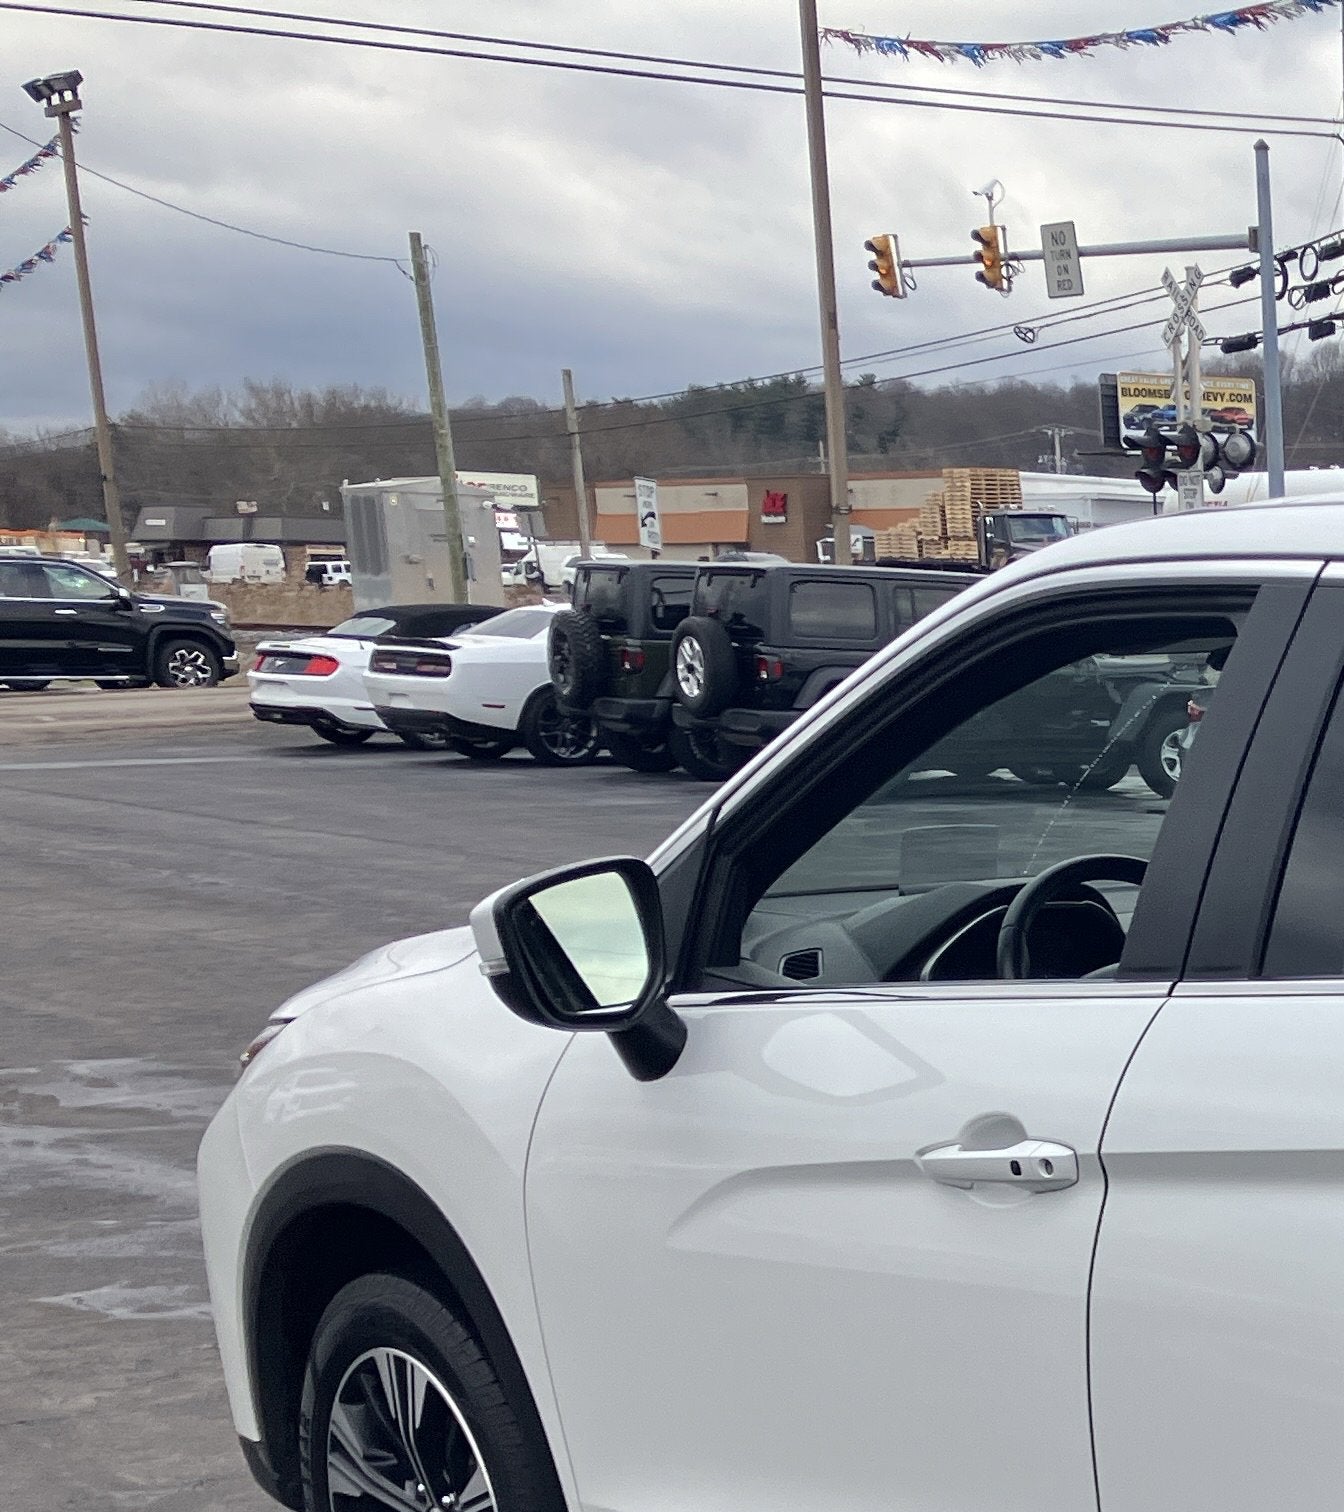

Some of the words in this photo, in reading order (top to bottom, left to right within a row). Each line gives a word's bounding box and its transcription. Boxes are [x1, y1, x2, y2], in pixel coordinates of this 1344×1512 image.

[1050, 230, 1066, 246] NO
[1050, 248, 1072, 261] TURN
[1056, 264, 1070, 276] ON
[1056, 278, 1073, 291] RED
[1163, 267, 1202, 344] CROSSING
